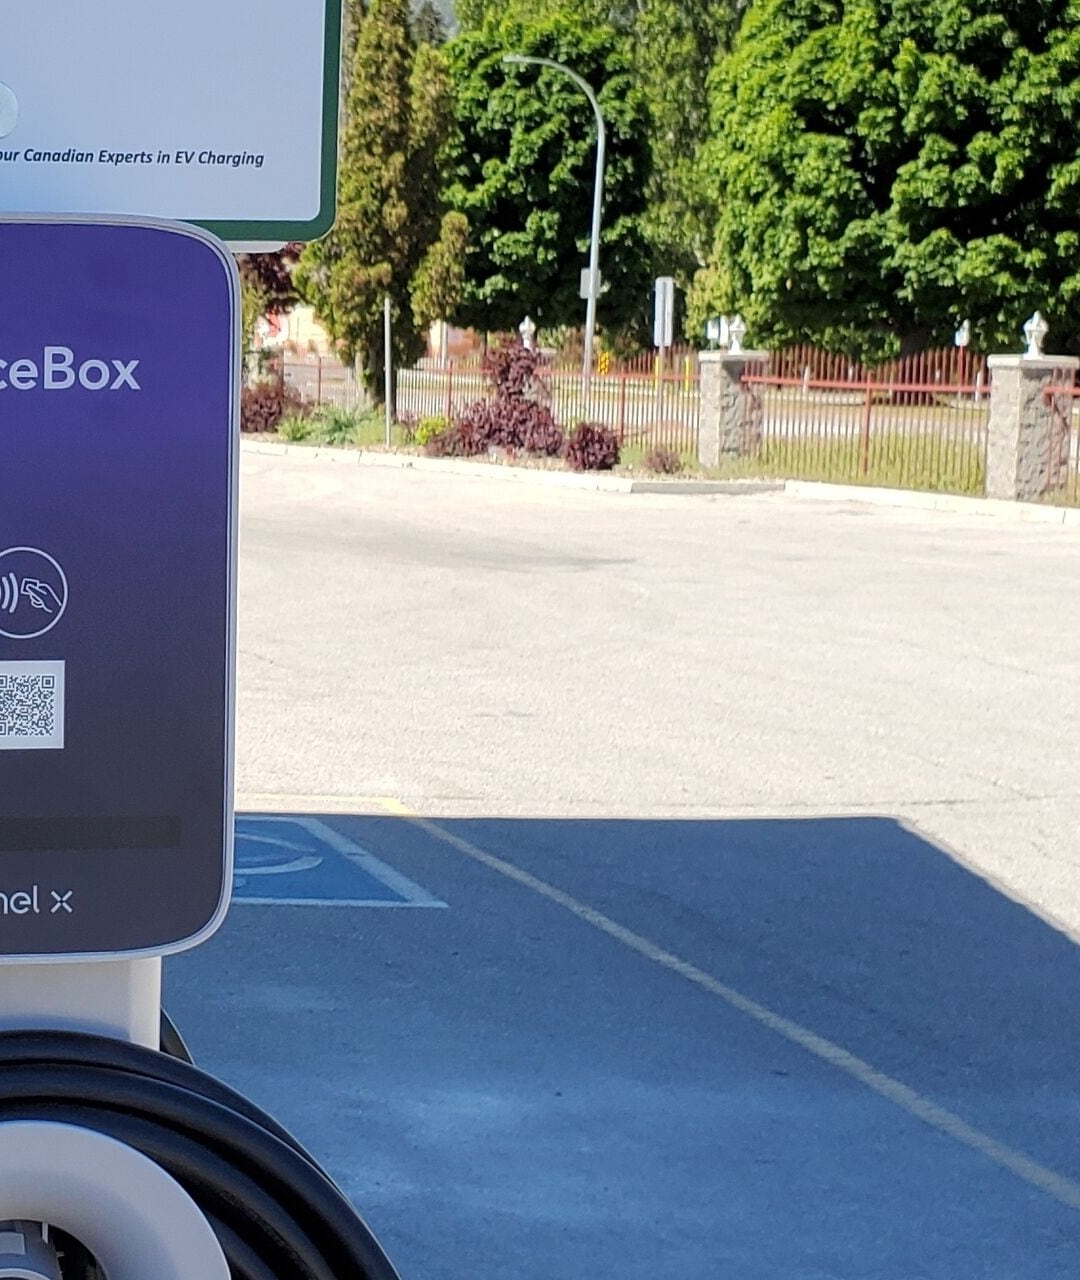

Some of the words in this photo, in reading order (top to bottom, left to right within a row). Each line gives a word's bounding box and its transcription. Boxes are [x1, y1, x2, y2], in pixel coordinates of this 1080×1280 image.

[23, 148, 94, 163] Canadian
[98, 149, 153, 167] Experts
[156, 150, 171, 164] in
[174, 150, 196, 164] EV
[198, 150, 265, 168] Charging
